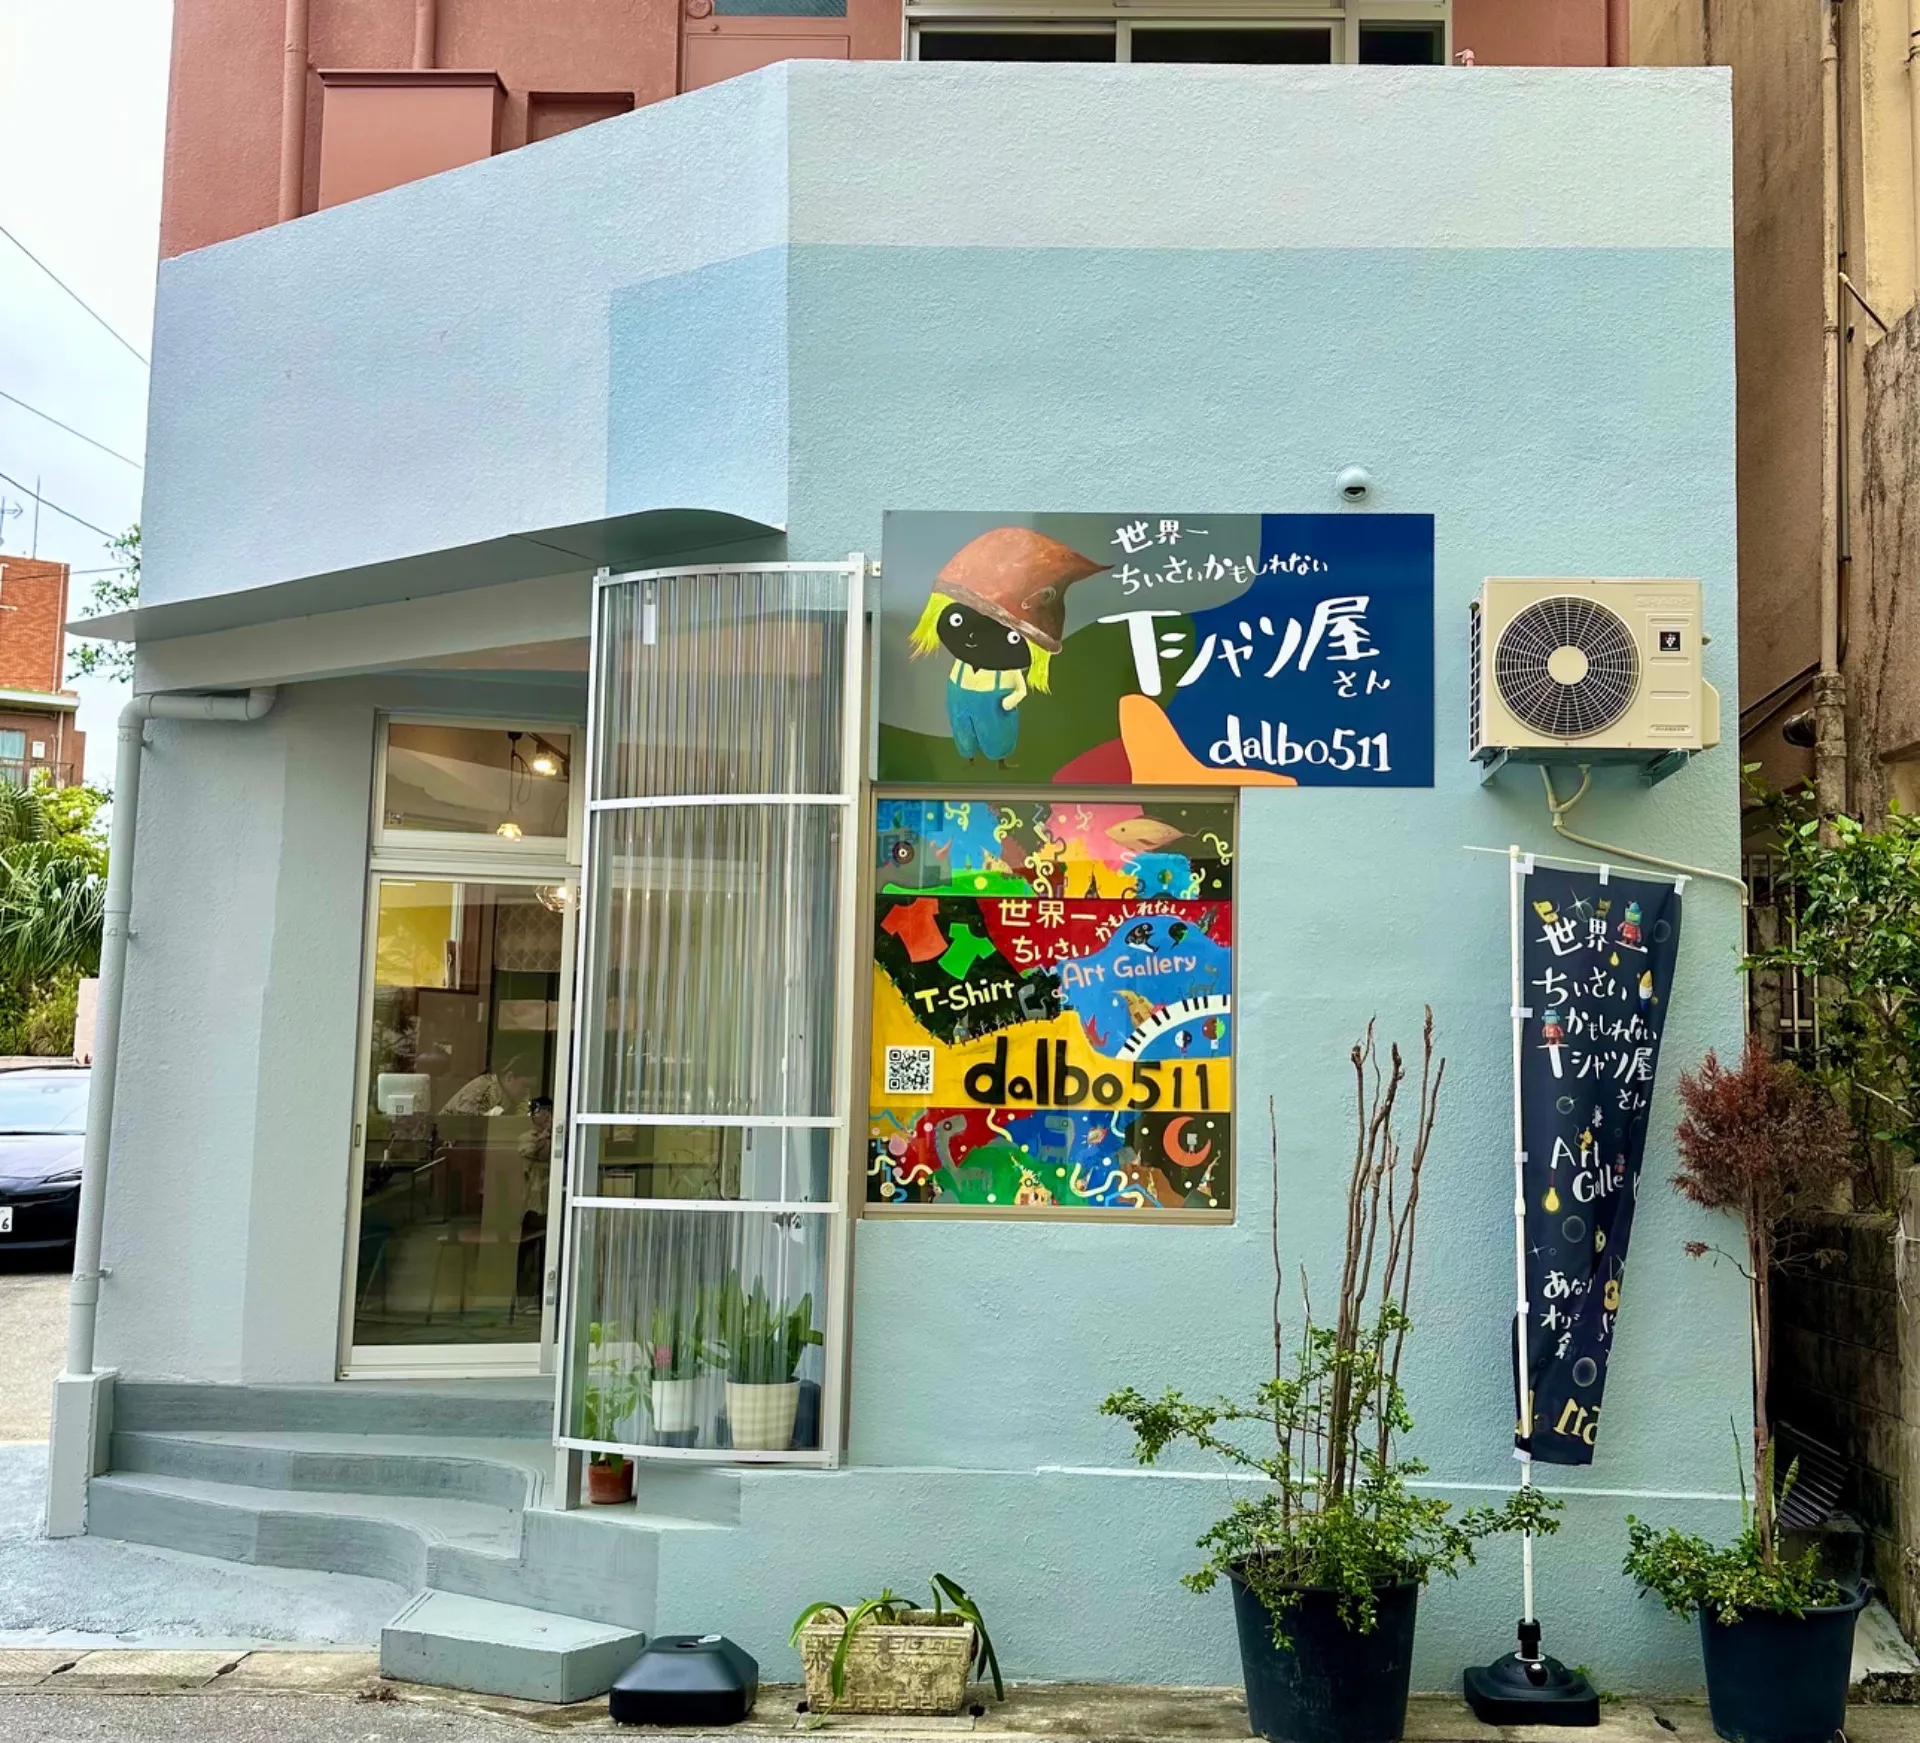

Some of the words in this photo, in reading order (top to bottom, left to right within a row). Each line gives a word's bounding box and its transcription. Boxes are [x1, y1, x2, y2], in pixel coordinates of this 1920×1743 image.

[1110, 519, 1209, 554] 世界一
[1111, 552, 1328, 596] ちいさいかもしれない
[1332, 669, 1391, 698] さん
[1208, 714, 1392, 772] dalbo511
[998, 899, 1098, 929] 世界一
[1095, 901, 1187, 942] かもしれない
[1012, 935, 1091, 963] ちいさい
[1535, 916, 1649, 957] 世界一
[1062, 962, 1106, 989] Art
[1113, 955, 1197, 979] Gallery
[1531, 965, 1628, 1008] ちいさい
[914, 978, 1015, 1013] T-Shirt
[1565, 1006, 1658, 1043] かもしれない
[964, 1035, 1210, 1110] dalbo511
[1616, 1088, 1647, 1111] さん
